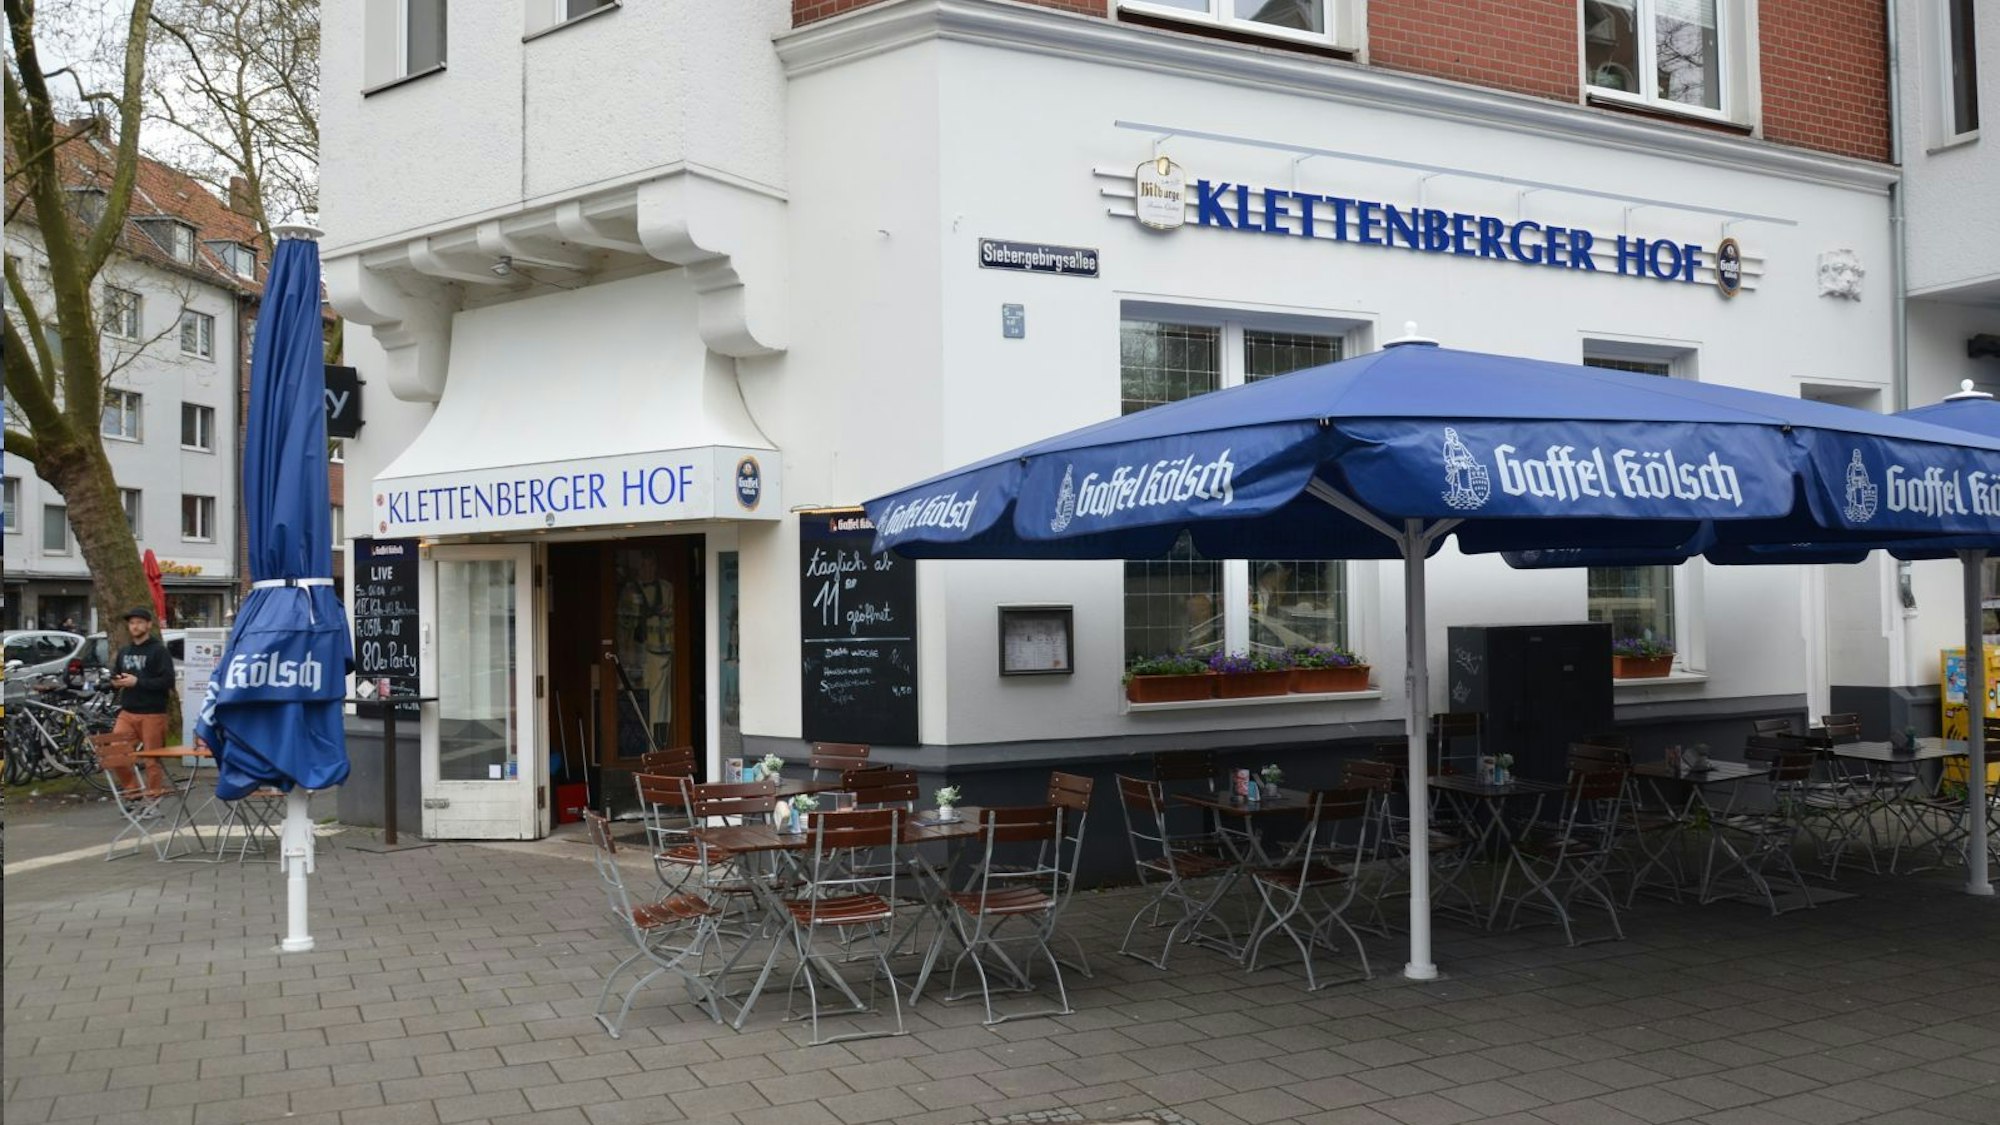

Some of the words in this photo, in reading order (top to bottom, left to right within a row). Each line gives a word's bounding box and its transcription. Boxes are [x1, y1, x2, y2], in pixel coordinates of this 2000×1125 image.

[1198, 179, 1597, 271] KLETTENBERGER
[1617, 235, 1703, 283] HOF
[983, 243, 1096, 272] Siebengebirgsallee
[388, 473, 607, 524] KLETTENBERGER
[622, 465, 694, 506] HOF
[1076, 463, 1149, 519] Gaffel
[1139, 448, 1235, 506] Kölsch
[1494, 443, 1616, 502] Gaffel
[1613, 448, 1743, 508] Kölsch
[1886, 464, 1969, 518] Gaffel
[884, 497, 930, 536] Gaffel
[919, 490, 980, 533] Kölsch
[371, 566, 393, 581] LIVE
[806, 547, 867, 581] täglich
[874, 551, 893, 571] ab
[846, 601, 894, 635] geöffnet
[225, 650, 322, 693] Kölsch
[388, 641, 417, 677] Party
